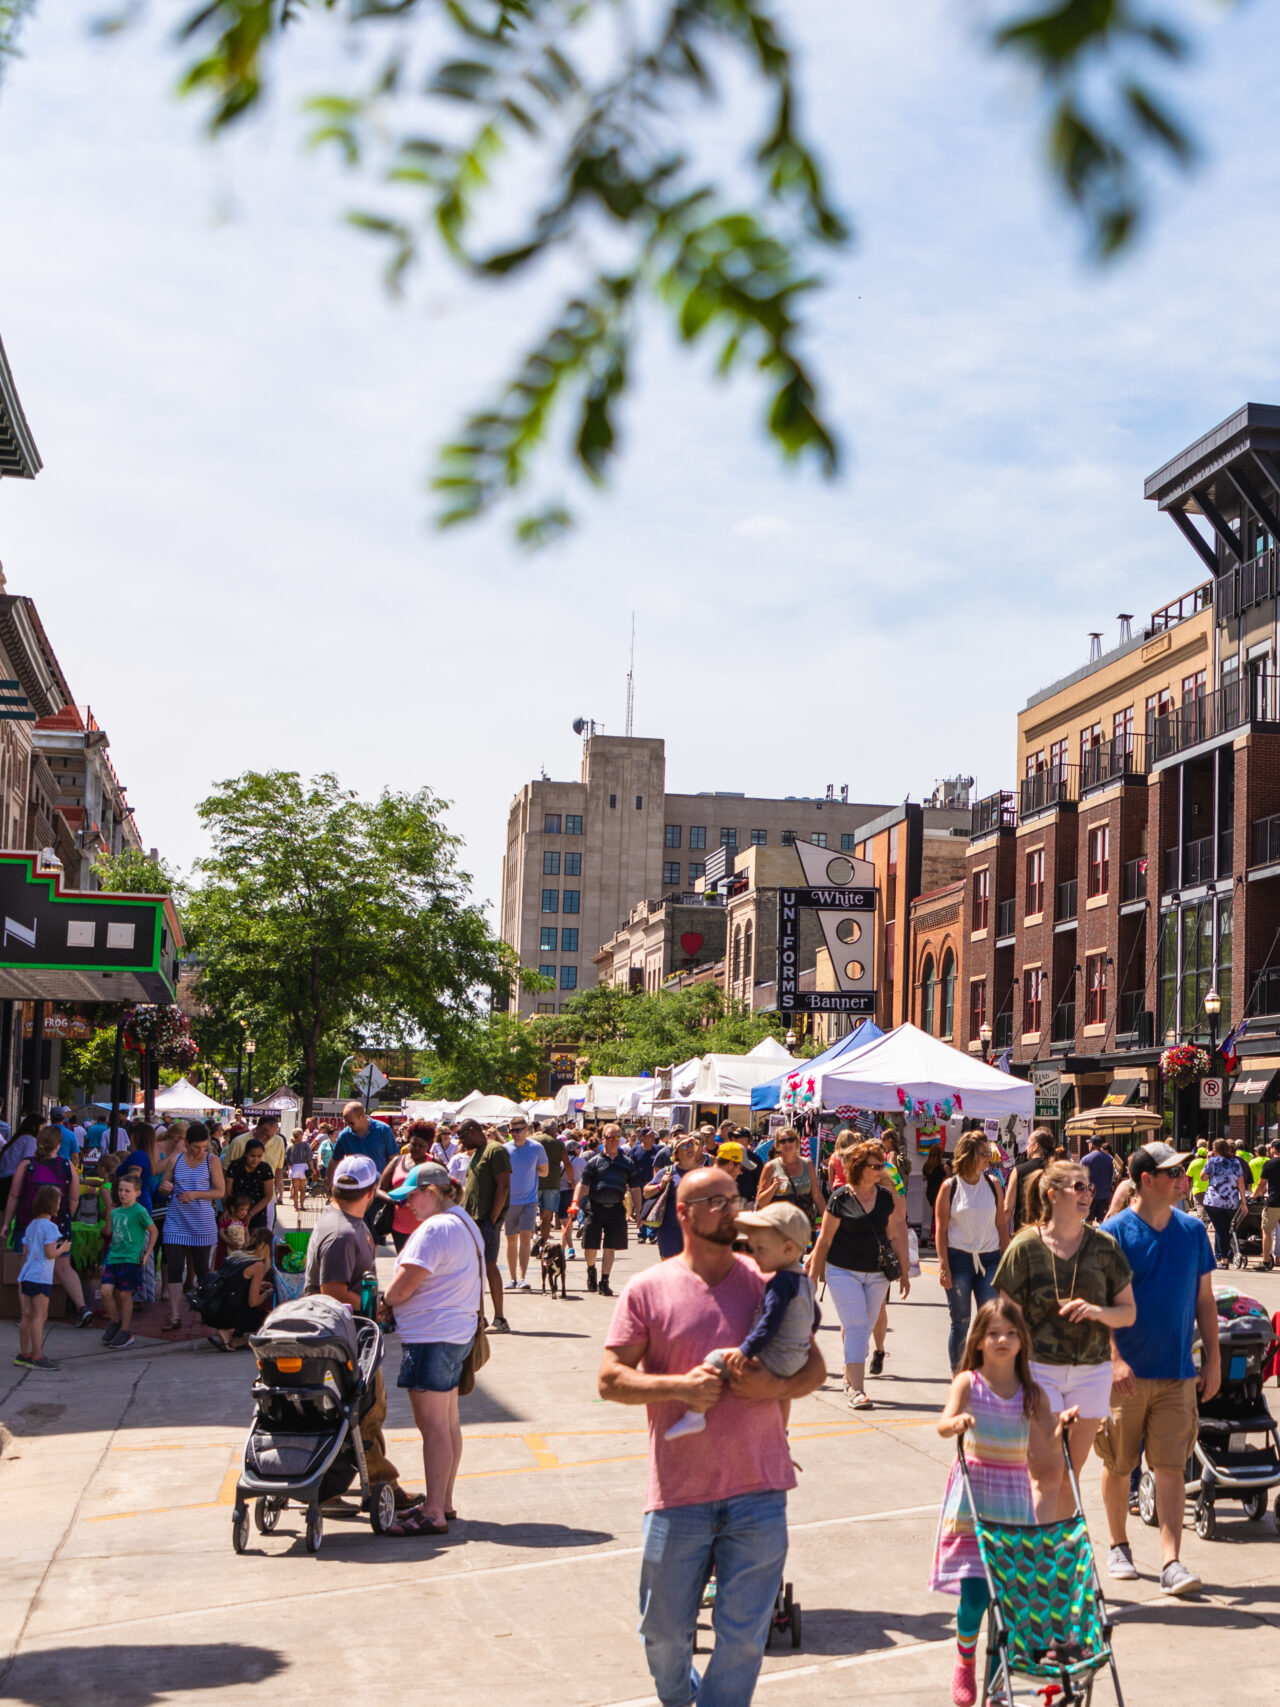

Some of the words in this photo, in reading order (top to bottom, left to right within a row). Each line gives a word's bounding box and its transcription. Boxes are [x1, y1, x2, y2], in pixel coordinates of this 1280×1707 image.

[811, 891, 864, 907] White
[782, 892, 796, 1007] UNIFORMS
[805, 994, 868, 1011] Banner
[44, 1017, 68, 1028] FROG
[556, 1072, 574, 1080] VFW
